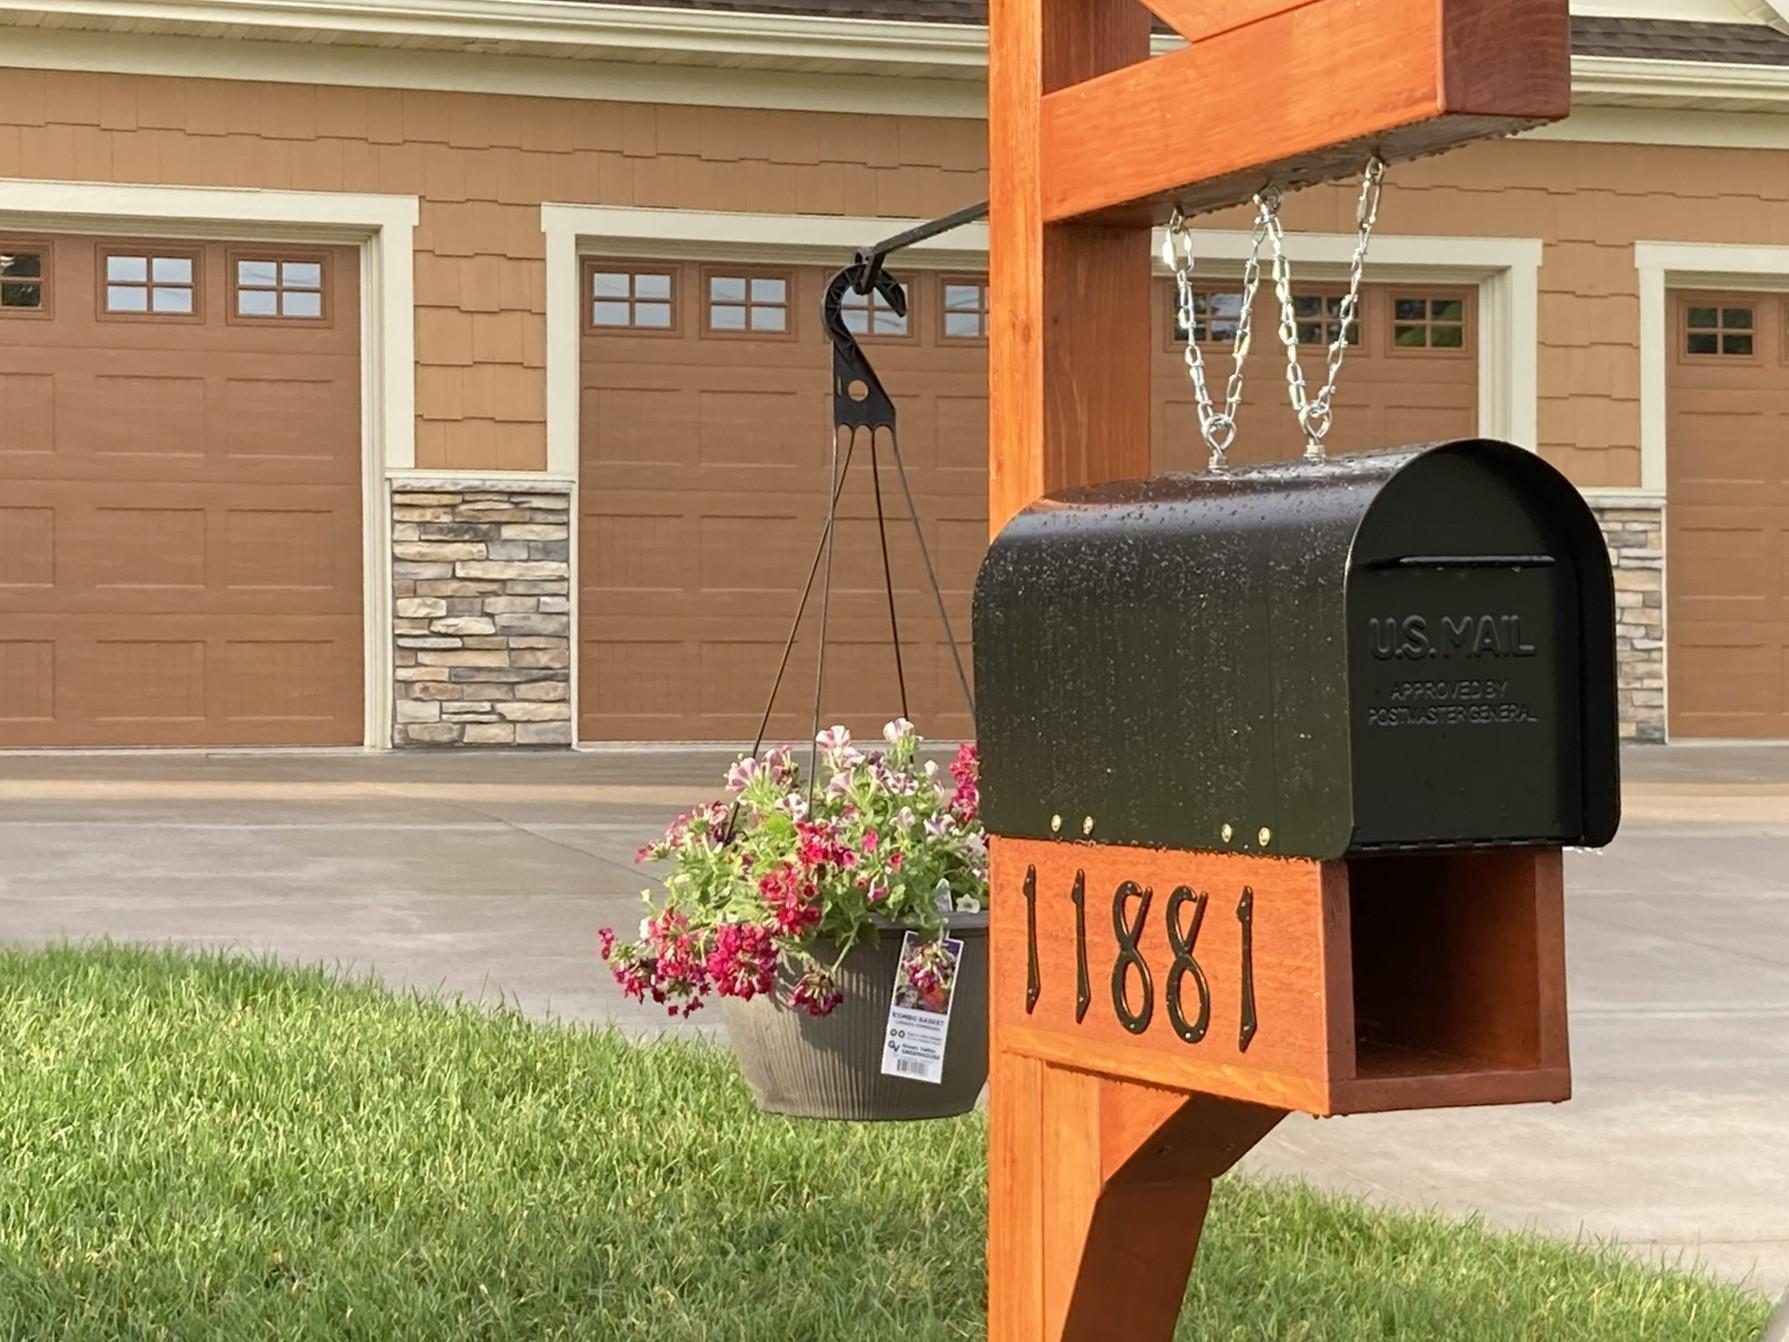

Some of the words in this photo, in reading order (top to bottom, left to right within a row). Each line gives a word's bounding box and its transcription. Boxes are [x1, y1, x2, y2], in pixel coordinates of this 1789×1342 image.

[1368, 614, 1437, 661] U.S.
[1440, 614, 1537, 659] MAIL
[1391, 680, 1481, 702] APPROVED
[1485, 680, 1508, 700] BY
[1368, 704, 1465, 727] POSTMASTER
[1469, 702, 1539, 724] GENERAL
[1022, 864, 1257, 1053] 11881
[919, 1017, 945, 1026] BASKET
